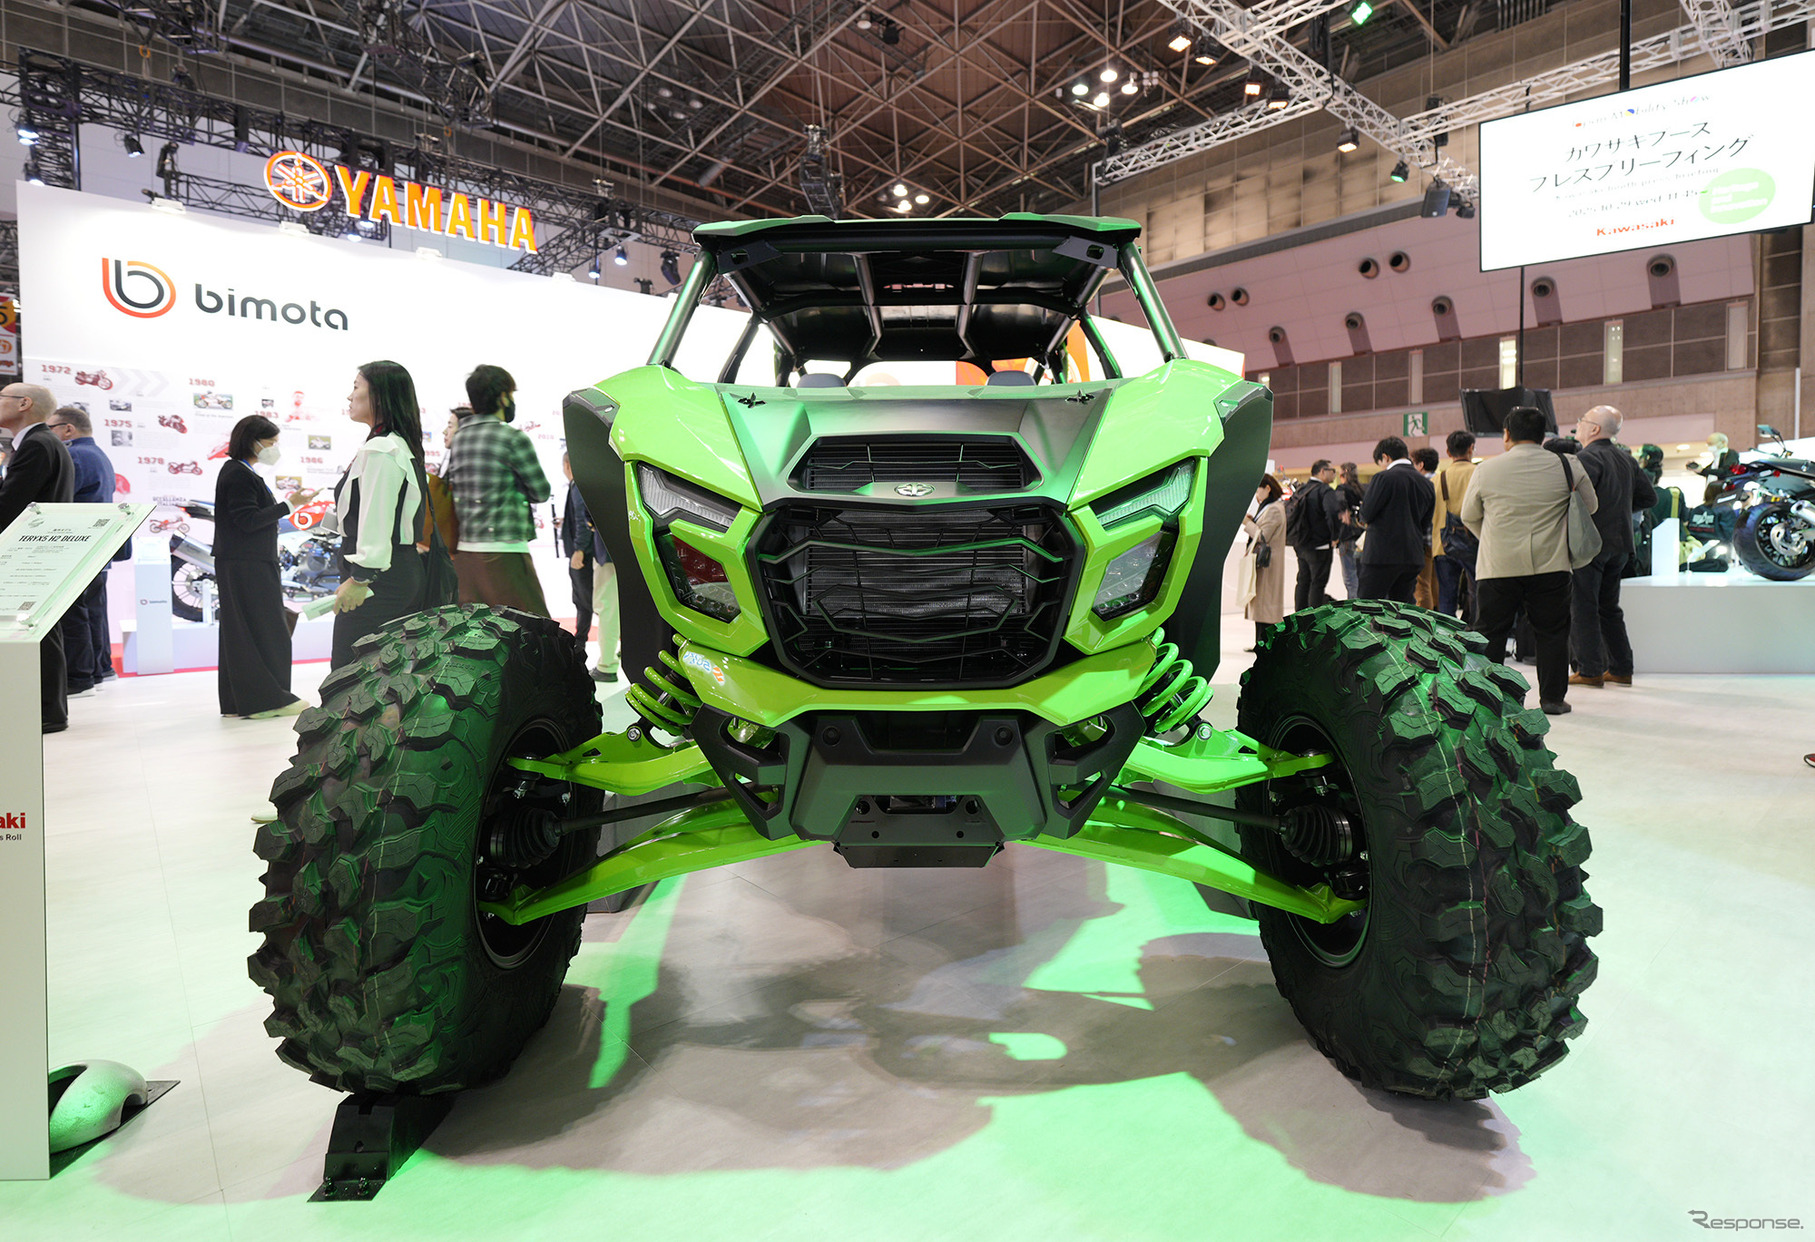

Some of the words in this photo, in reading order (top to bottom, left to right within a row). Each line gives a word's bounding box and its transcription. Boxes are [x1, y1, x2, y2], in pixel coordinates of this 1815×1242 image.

[334, 164, 538, 254] YAMAHA
[1596, 218, 1675, 236] Kawasaki
[195, 283, 349, 330] bimota
[41, 364, 72, 374] 1972
[188, 378, 215, 387] 1980
[104, 419, 133, 428] 1975
